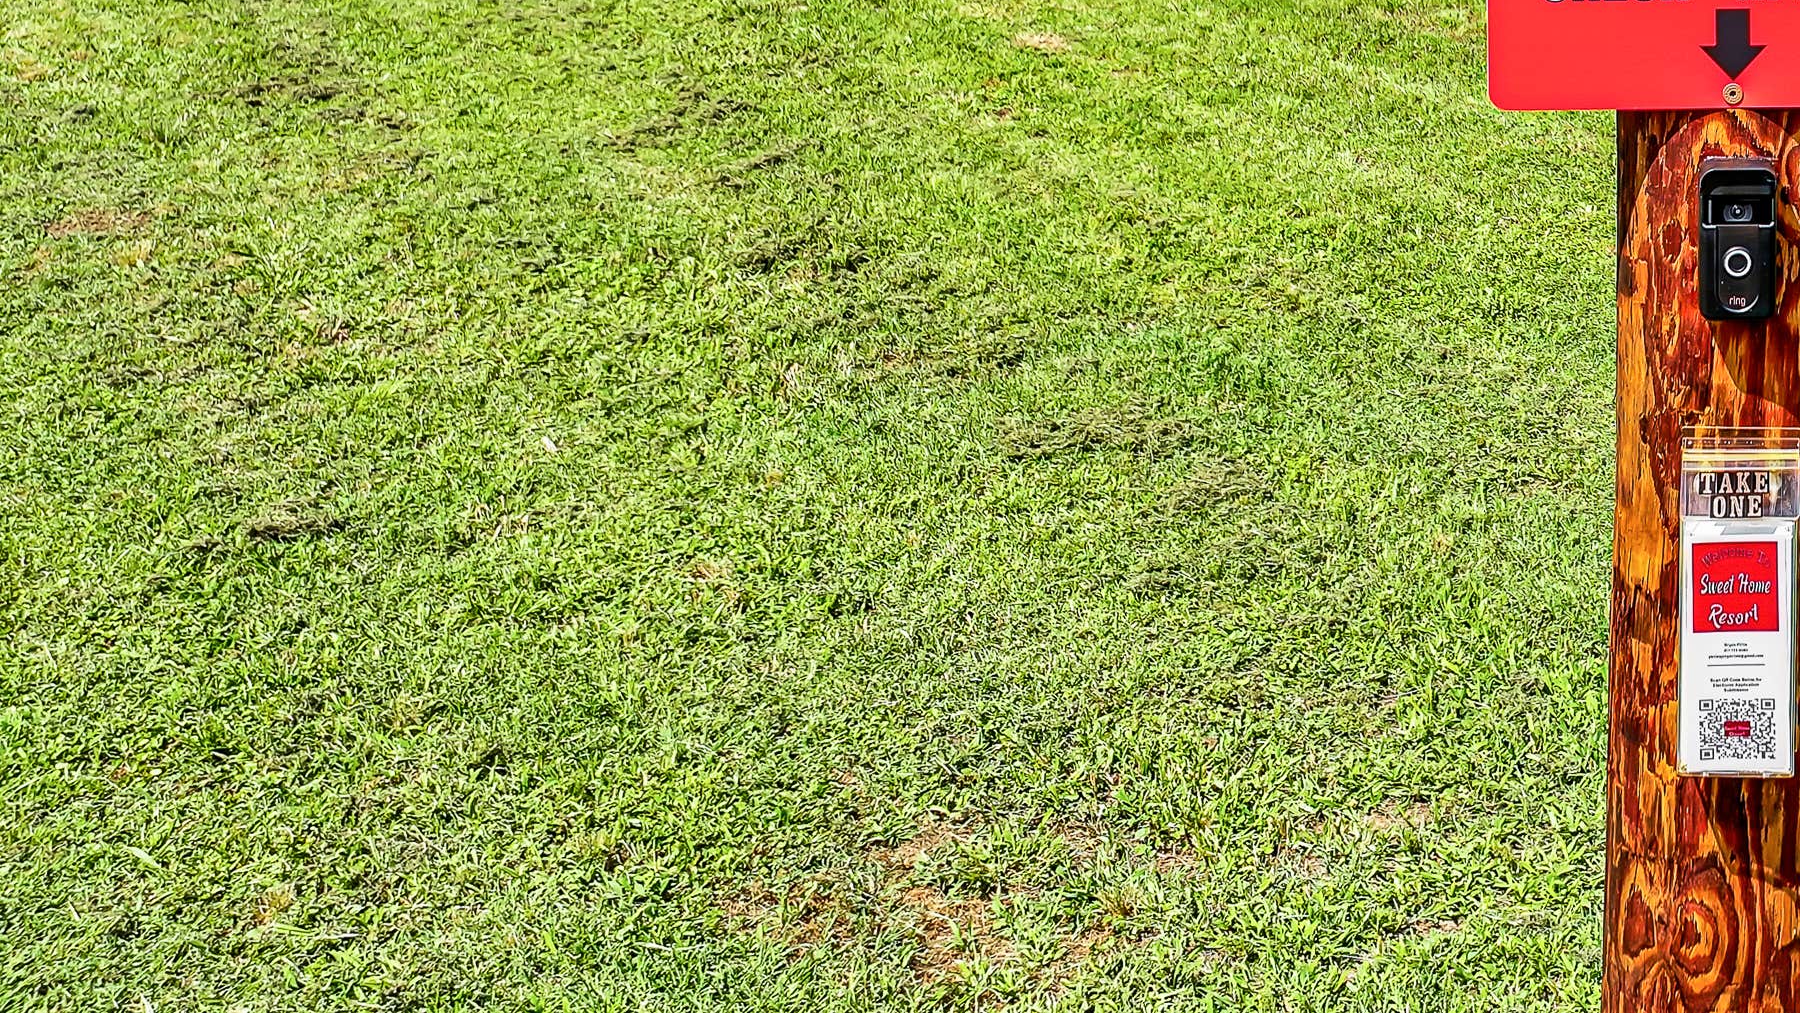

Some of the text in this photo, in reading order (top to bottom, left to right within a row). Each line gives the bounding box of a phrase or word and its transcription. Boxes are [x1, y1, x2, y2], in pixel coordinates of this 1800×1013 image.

[1729, 295, 1746, 307] ring
[1701, 472, 1769, 494] TAKE
[1712, 495, 1762, 517] ONE
[1700, 573, 1771, 594] Sweet Home
[1708, 603, 1758, 628] Resort
